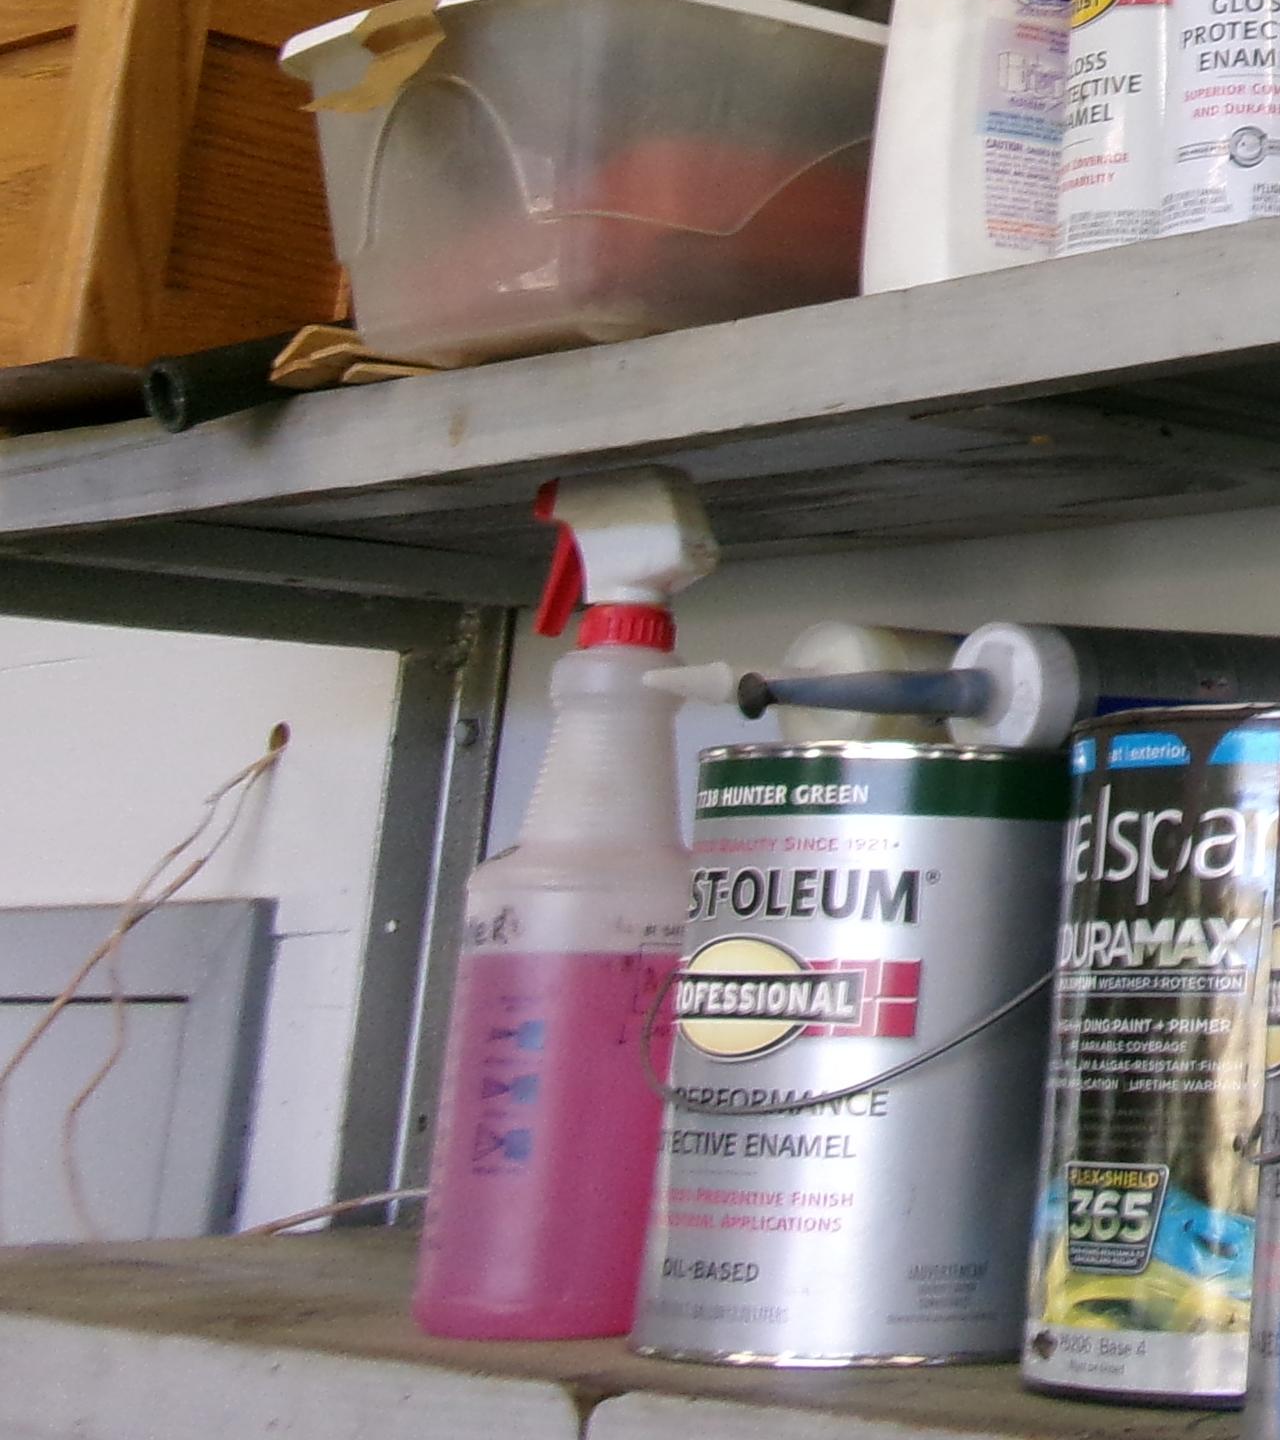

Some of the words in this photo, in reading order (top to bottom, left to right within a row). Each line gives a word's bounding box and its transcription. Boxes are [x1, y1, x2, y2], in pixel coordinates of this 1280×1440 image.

[1071, 50, 1108, 78] OSS
[1068, 73, 1143, 104] ECTIVE
[1184, 83, 1247, 103] SUPERIOR
[1192, 104, 1221, 120] AND
[1131, 742, 1187, 760] exterior
[721, 784, 788, 808] HUNTER
[792, 783, 870, 806] GREEN
[783, 836, 839, 853] SINCE
[1058, 917, 1252, 972] DURAMAX
[1100, 976, 1151, 991] WEATHER
[1112, 1018, 1153, 1033] PAINT
[1168, 1018, 1232, 1033] PRIMER
[1125, 1040, 1189, 1053] COVERAGE
[1128, 1078, 1179, 1092] LIFETIME
[668, 1128, 738, 1158] ECTIVE
[745, 1132, 857, 1159] ENAMEL
[1068, 1170, 1160, 1189] FLEX-SHIELD
[791, 1191, 855, 1208] FINISH
[720, 1214, 843, 1233] APPLICATIONS
[1068, 1190, 1155, 1243] 365
[661, 1257, 760, 1284] OIL-BASED
